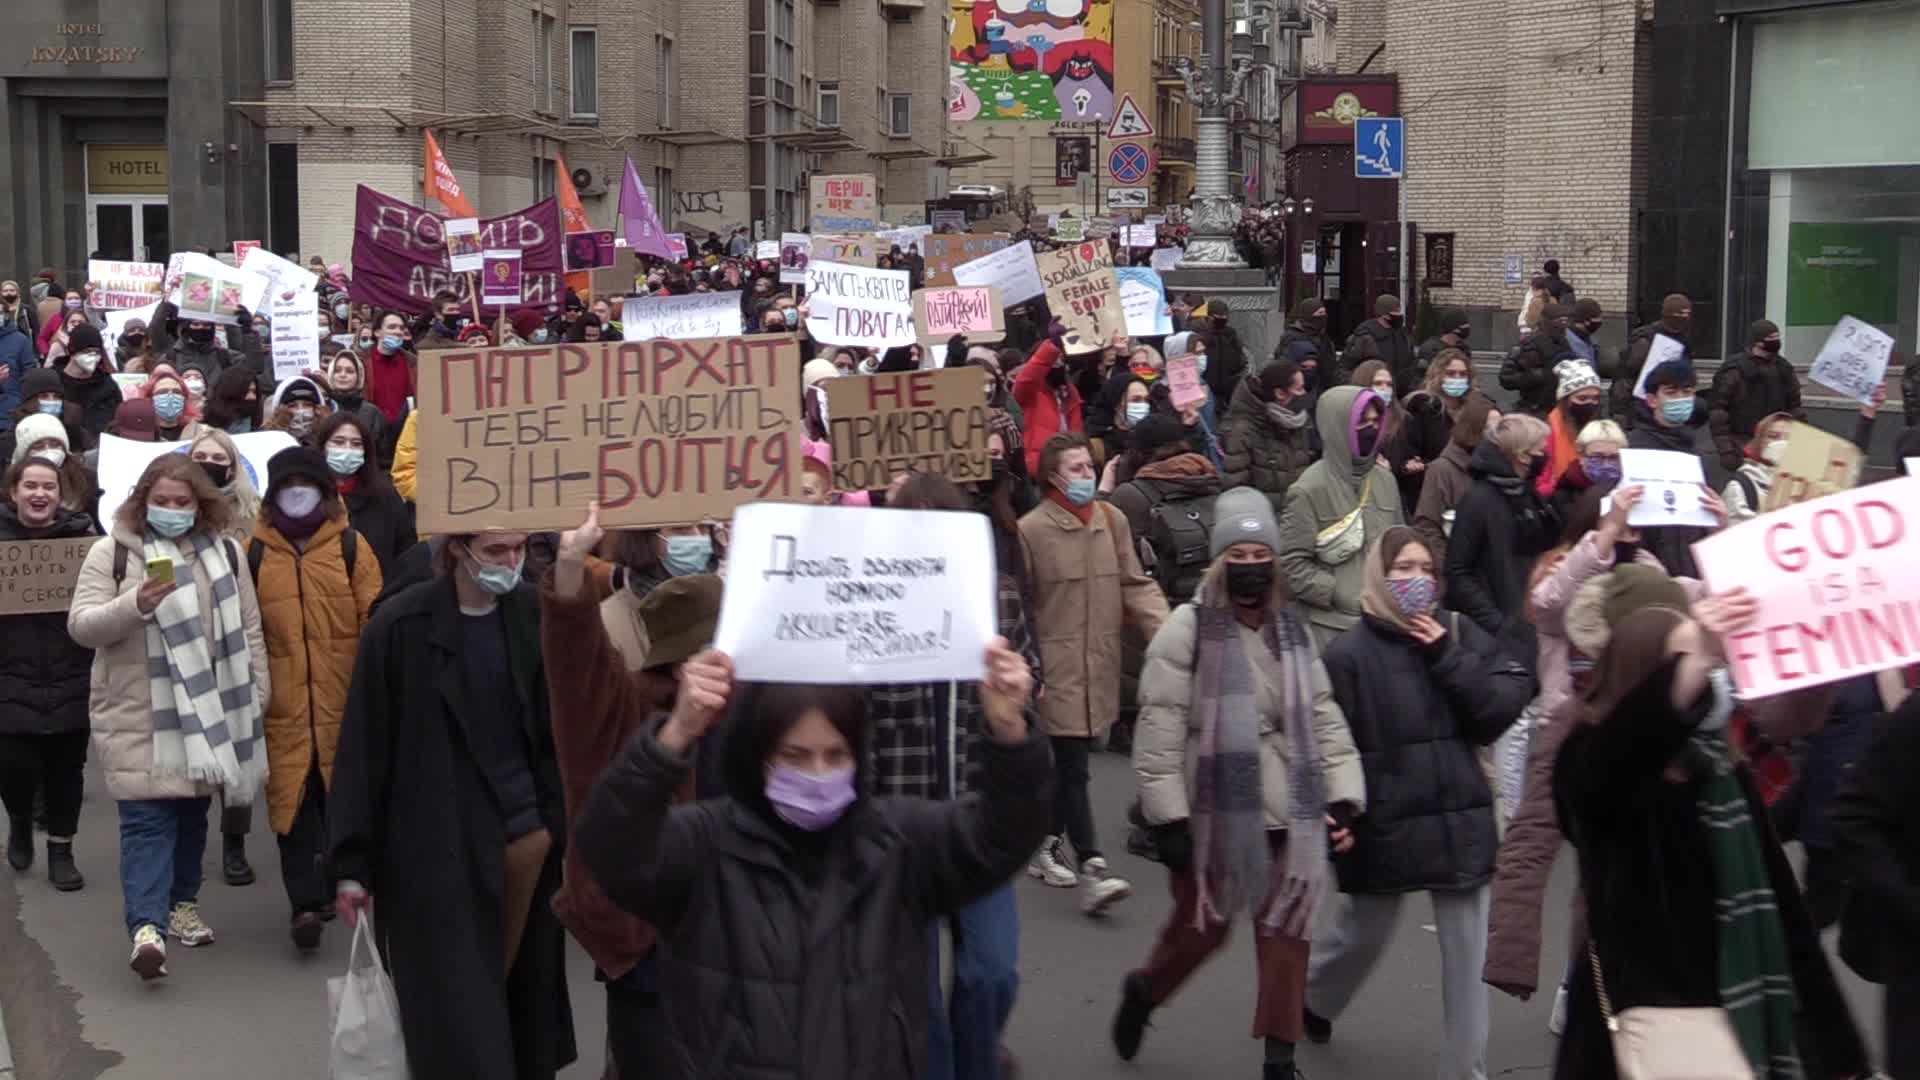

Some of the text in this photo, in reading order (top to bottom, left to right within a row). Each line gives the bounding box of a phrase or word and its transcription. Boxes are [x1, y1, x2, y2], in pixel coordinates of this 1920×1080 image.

[57, 23, 103, 35] HOTEL
[31, 47, 143, 64] KOZATSKY
[109, 161, 163, 174] HOTEL
[825, 181, 864, 197] ПЕРШ
[1056, 240, 1103, 268] STOP
[1044, 255, 1114, 288] SEXUALIZING
[1062, 276, 1110, 301] FEMALE
[1071, 293, 1106, 316] BODY
[440, 337, 794, 416] ПАТРІАРХАТ
[867, 372, 937, 410] НЕ
[454, 405, 569, 449] ТЕБЕ
[582, 400, 627, 440] НЕ
[831, 406, 985, 460] ПРИКРАСА
[598, 432, 792, 511] БОЇТЬСЯ
[1764, 500, 1907, 572] GOD
[1856, 566, 1888, 594] A
